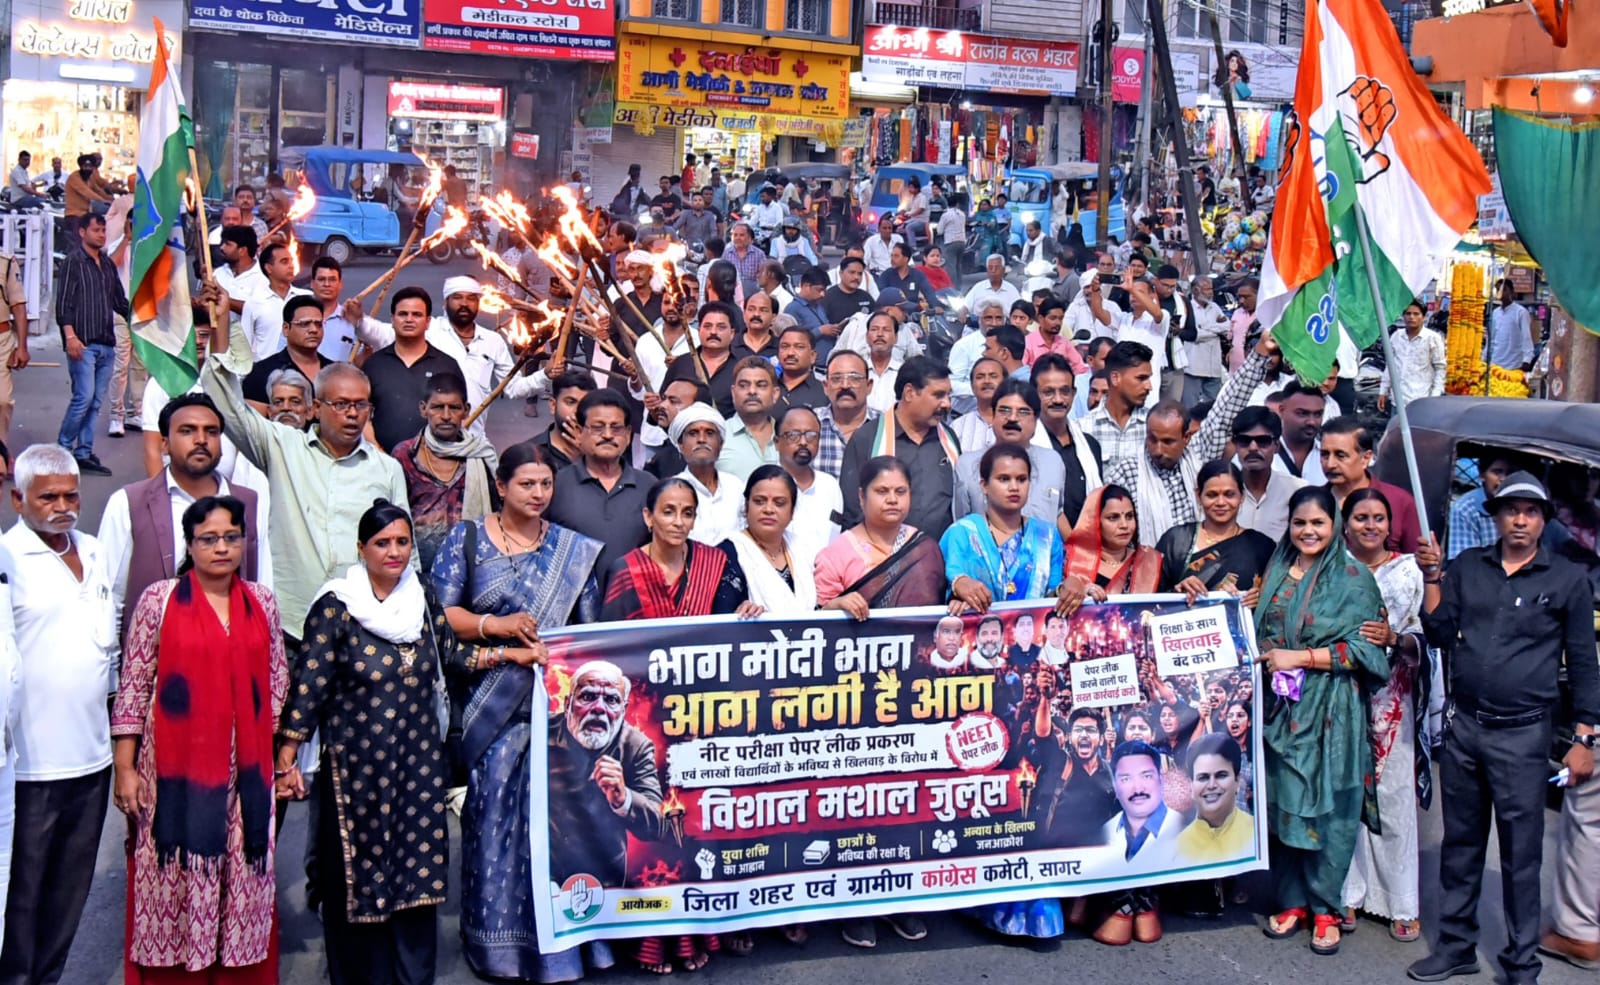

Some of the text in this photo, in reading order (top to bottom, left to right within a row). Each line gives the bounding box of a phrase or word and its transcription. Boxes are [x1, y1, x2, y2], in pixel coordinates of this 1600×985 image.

[194, 7, 215, 17] दवा
[219, 6, 232, 17] के
[236, 8, 263, 21] थोक
[266, 11, 305, 25] विक्रेता
[334, 13, 413, 36] मेडिसेल्स
[472, 9, 568, 28] मेडीकल स्टोर्स
[442, 27, 461, 36] प्रकार
[462, 26, 473, 37] की
[529, 34, 538, 42] पर
[558, 36, 568, 44] का
[568, 37, 580, 47] एक
[970, 39, 1076, 66] राजीव वस्त्र भंडार
[735, 80, 745, 93] &
[663, 106, 718, 127] मेडीको
[1160, 618, 1217, 635] शिक्षा के साथ
[1162, 631, 1222, 653] खिलवाड़
[648, 627, 914, 686] भाग मोदी भाग
[1172, 650, 1215, 667] बंद करो
[1084, 662, 1119, 675] पेपर लीक
[1080, 677, 1097, 688] करने
[1118, 675, 1127, 683] पर
[662, 669, 994, 737] आग लगी है आग
[956, 722, 993, 748] NEET
[700, 732, 915, 762] नीट परीक्षा पेपर लीक प्रकरण
[961, 741, 999, 760] पेपर लीक
[682, 750, 938, 781] एवं लाखों विद्यार्थियों के भविष्य से खिलवाड़ के विरोध में
[697, 774, 1010, 832] विशाल मशाल जुलूस
[963, 821, 1036, 837] अन्याय के खिलाफ
[836, 833, 876, 849] छात्रों के
[975, 835, 1024, 850] जनआक्रोश
[721, 843, 770, 864] युवा शक्ति
[837, 846, 911, 863] भविष्य की रक्षा हेतु
[723, 864, 736, 875] का
[682, 857, 1081, 912] जिला शहर एवं ग्रामीण कांग्रेस कमेटी, सागर
[621, 898, 662, 911] आयोजक
